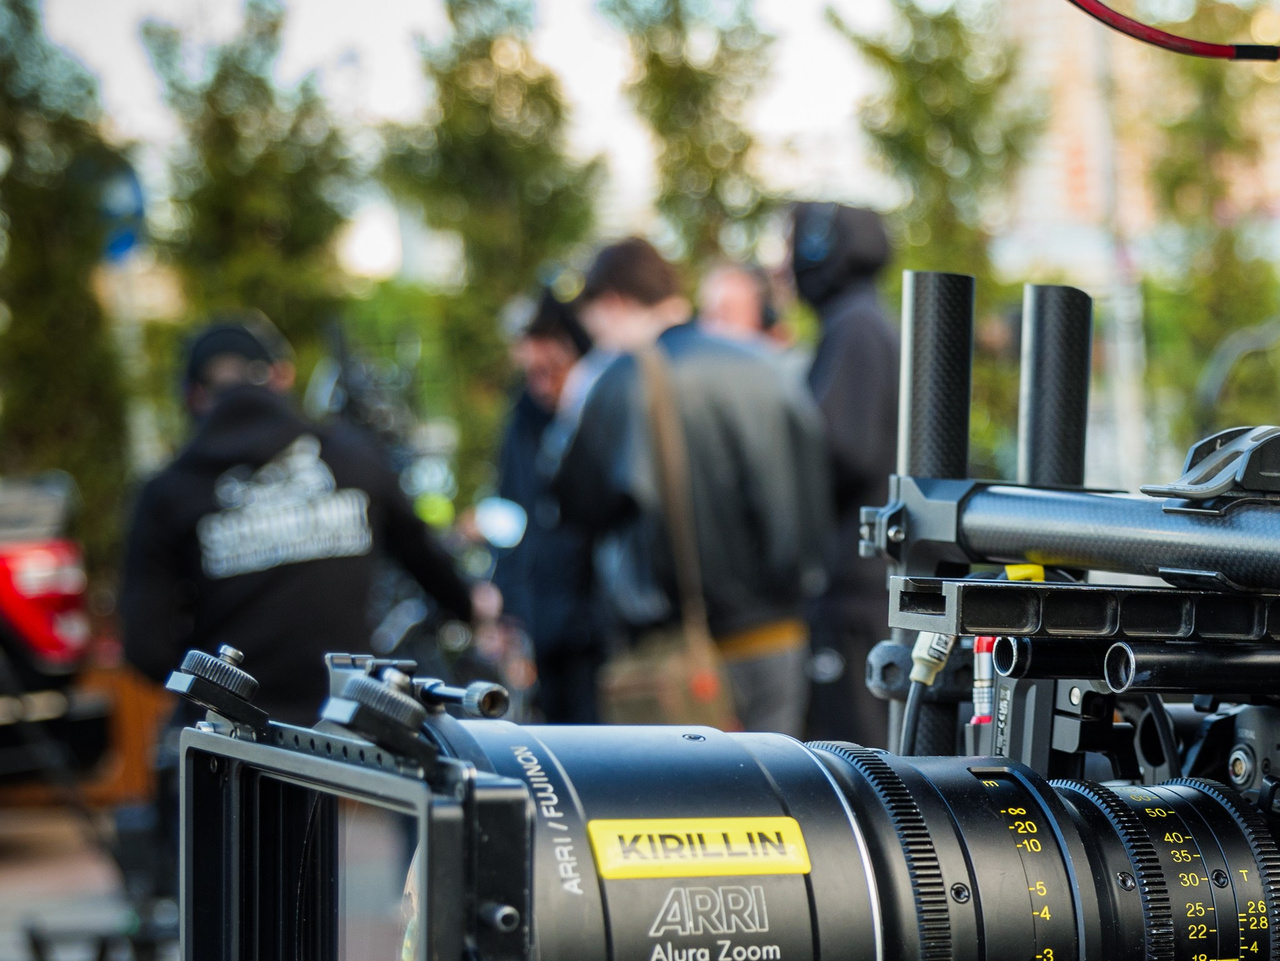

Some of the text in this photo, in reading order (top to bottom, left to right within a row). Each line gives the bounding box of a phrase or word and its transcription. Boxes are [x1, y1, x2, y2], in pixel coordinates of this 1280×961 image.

[511, 745, 564, 819] FUJINON
[1145, 807, 1167, 818] 50
[1163, 831, 1184, 844] 40
[617, 831, 788, 860] KIRILLIN
[1170, 849, 1192, 863] 35
[552, 837, 584, 895] ARRI
[1178, 872, 1200, 888] 30
[1239, 870, 1249, 882] T
[649, 885, 769, 937] ARRI
[1185, 902, 1206, 917] 25
[1247, 901, 1267, 914] 2.6
[1249, 915, 1269, 930] 2.8
[1188, 923, 1207, 940] 22
[717, 940, 781, 961] Zoom
[1250, 941, 1259, 953] 4
